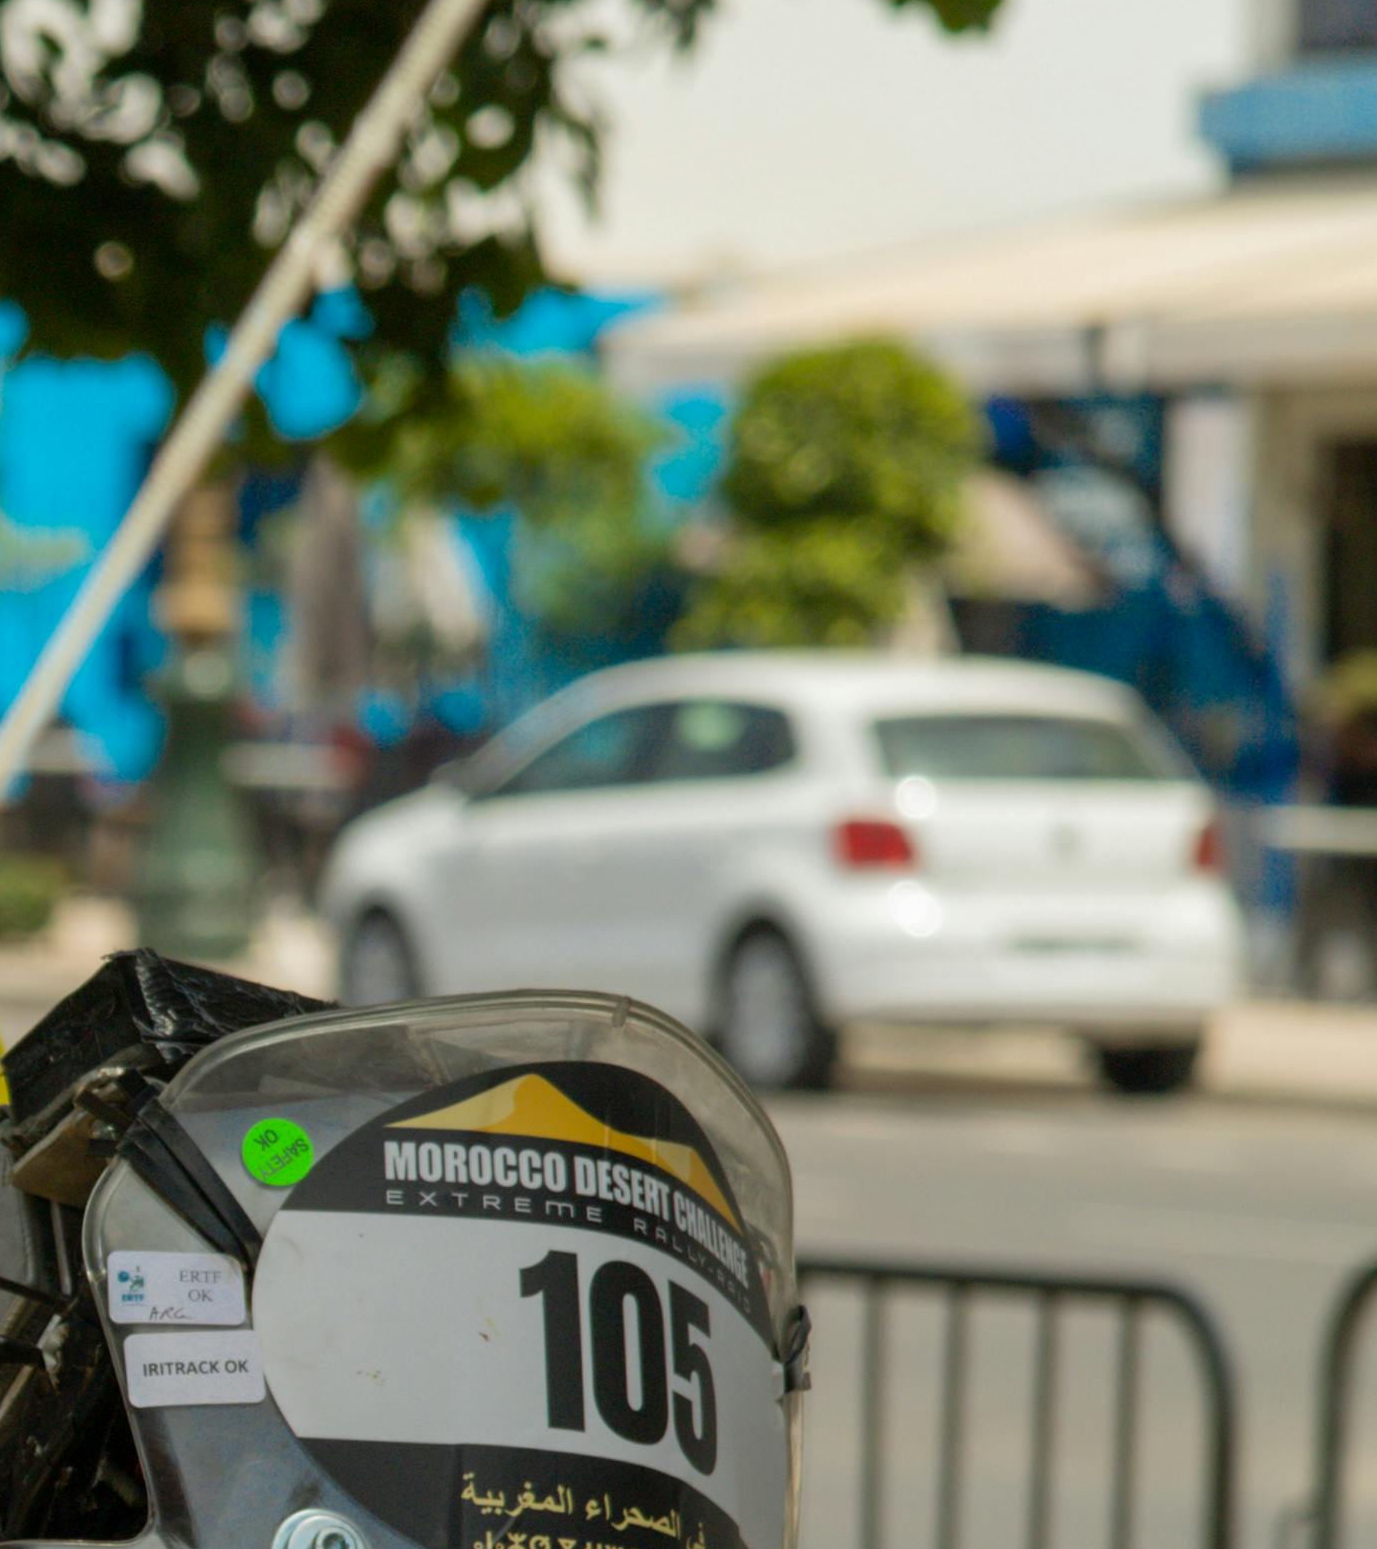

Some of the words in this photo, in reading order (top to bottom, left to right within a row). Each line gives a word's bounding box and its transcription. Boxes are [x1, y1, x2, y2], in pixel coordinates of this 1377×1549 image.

[253, 1129, 279, 1152] OK
[384, 1140, 566, 1193] MOROCCO
[573, 1155, 672, 1223] DESERT
[386, 1189, 603, 1223] EXTREME
[179, 1270, 221, 1284] ERTF
[188, 1289, 214, 1303] OK
[143, 1361, 221, 1377] IRITRACK
[224, 1359, 249, 1374] OK
[519, 1249, 718, 1477] 105
[461, 1472, 574, 1517] المغربية
